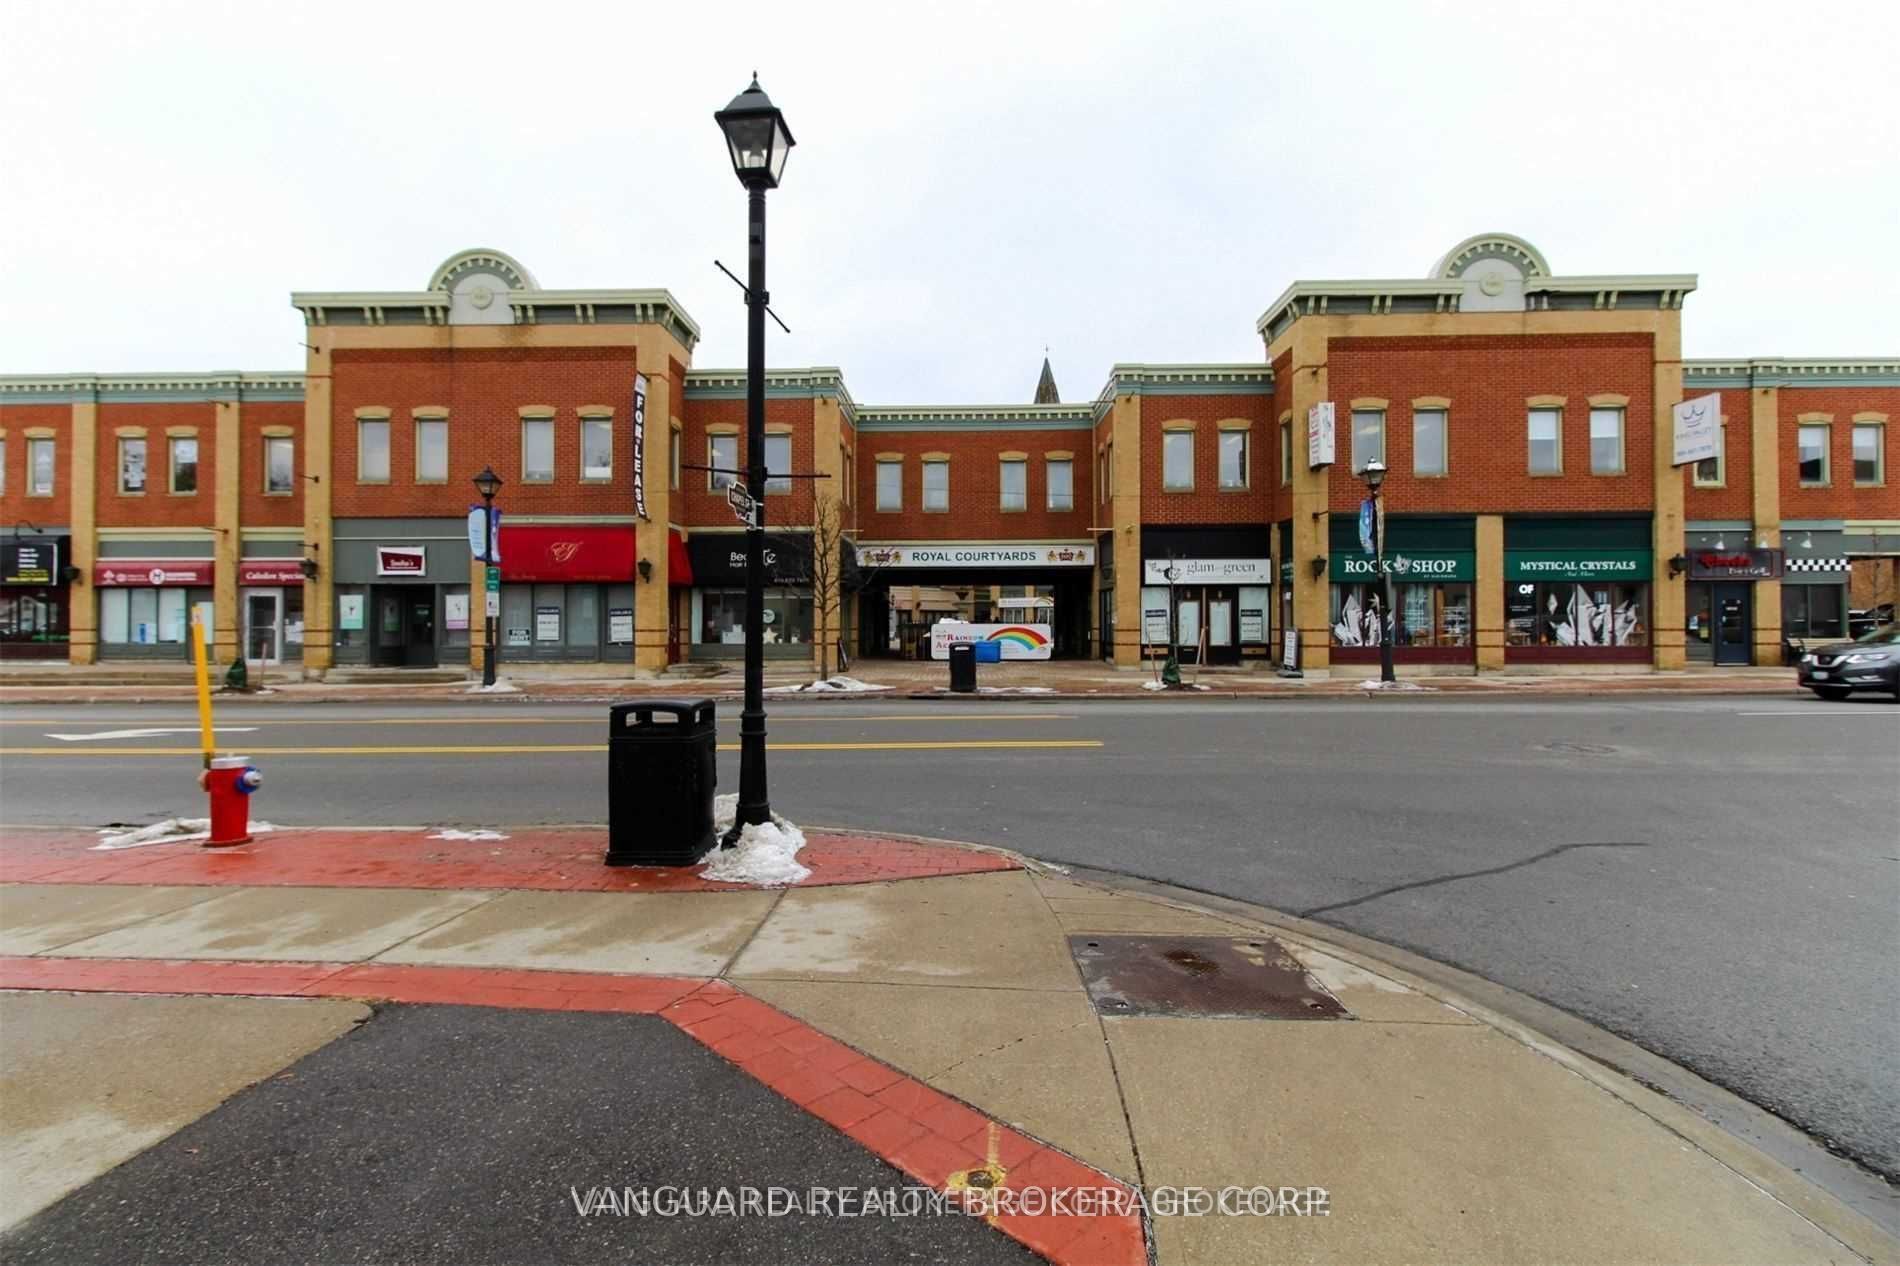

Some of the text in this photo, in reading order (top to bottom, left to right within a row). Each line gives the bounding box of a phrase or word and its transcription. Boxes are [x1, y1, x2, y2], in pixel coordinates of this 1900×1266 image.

[634, 395, 646, 515] FOR LEASE
[912, 551, 1036, 561] ROYAL COURTYARDS
[1186, 560, 1256, 576] glam green
[1344, 560, 1457, 573] ROCK SHOP
[1520, 561, 1637, 571] MYSTICAL CRYSTALS
